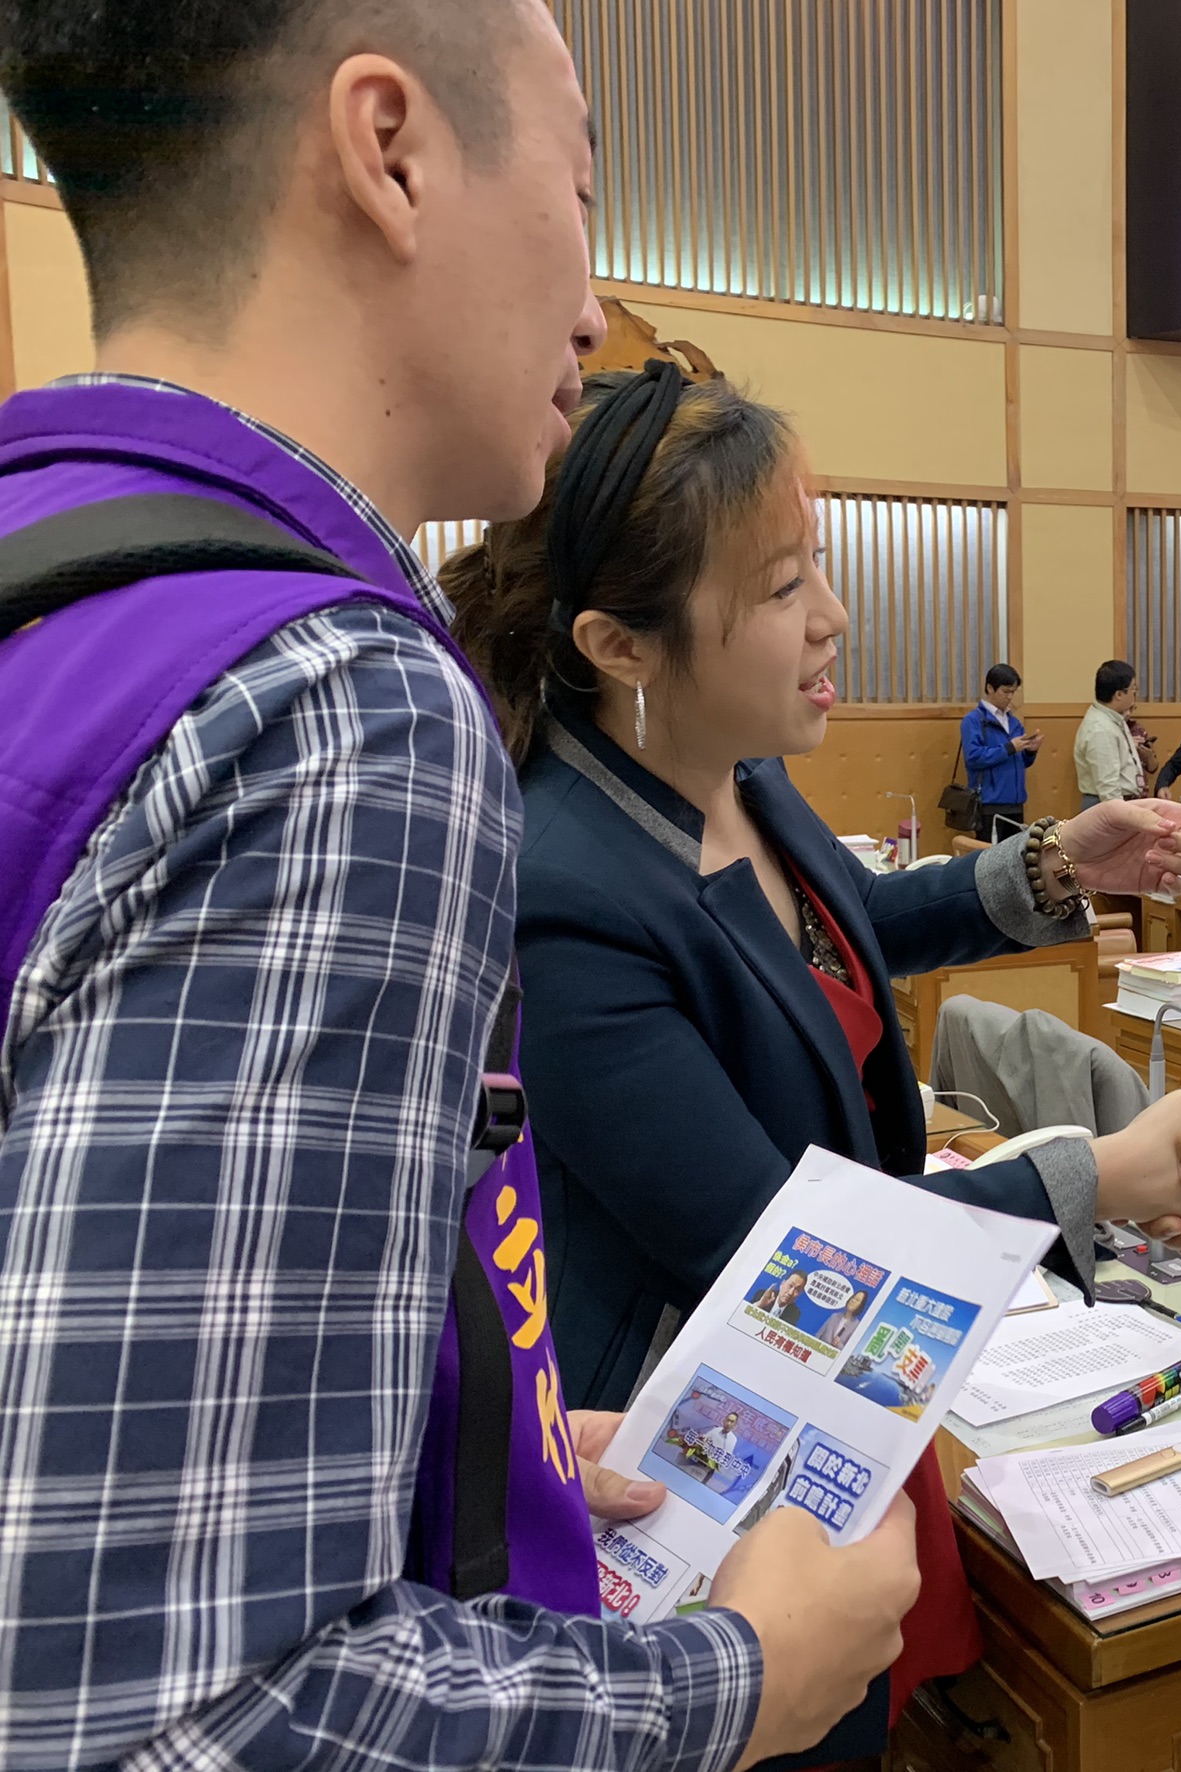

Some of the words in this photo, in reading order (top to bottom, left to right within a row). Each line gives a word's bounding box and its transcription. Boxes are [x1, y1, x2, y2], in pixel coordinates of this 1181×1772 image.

[792, 1233, 885, 1289] 侯市長的心裡話
[754, 1326, 813, 1363] 人民有權知道
[684, 1428, 752, 1480] 每一次我到中央
[806, 1444, 869, 1496] 關於新北
[597, 1527, 669, 1585] 我們從不反對
